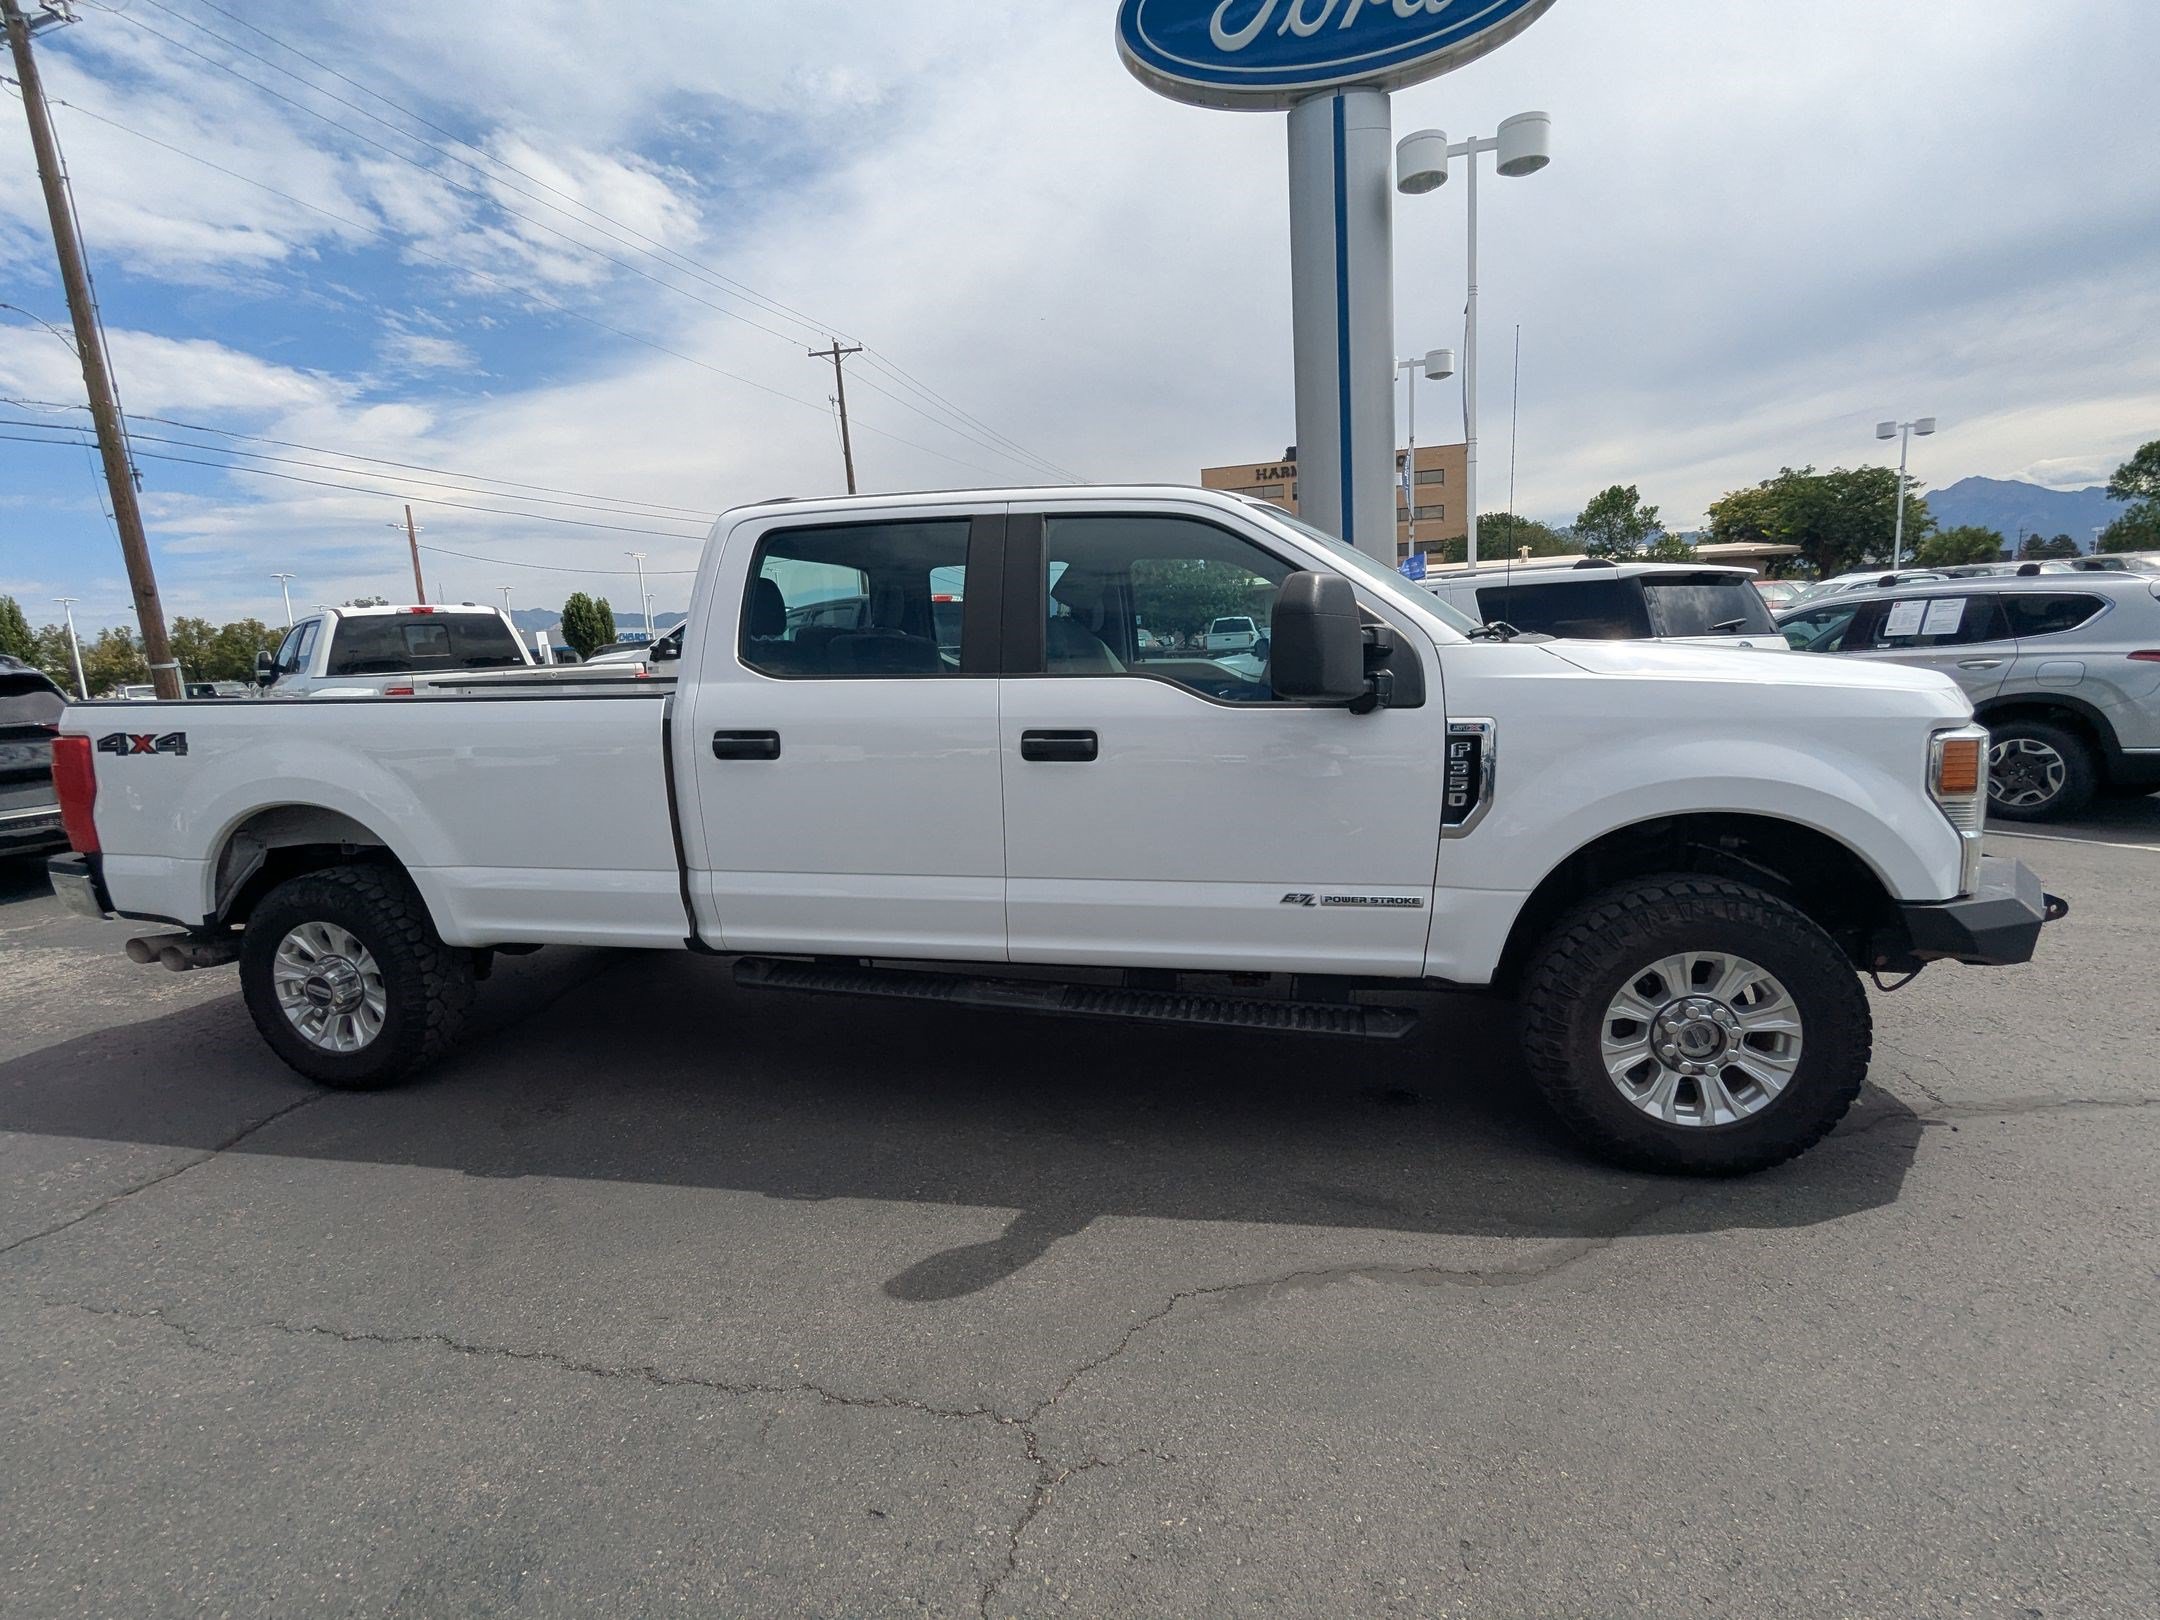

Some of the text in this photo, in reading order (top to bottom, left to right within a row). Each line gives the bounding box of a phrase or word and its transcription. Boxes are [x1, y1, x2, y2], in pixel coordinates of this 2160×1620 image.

[1210, 0, 1454, 52] or
[97, 732, 188, 756] 4X4
[1324, 896, 1367, 904] POWER
[1369, 897, 1421, 905] STROKE
